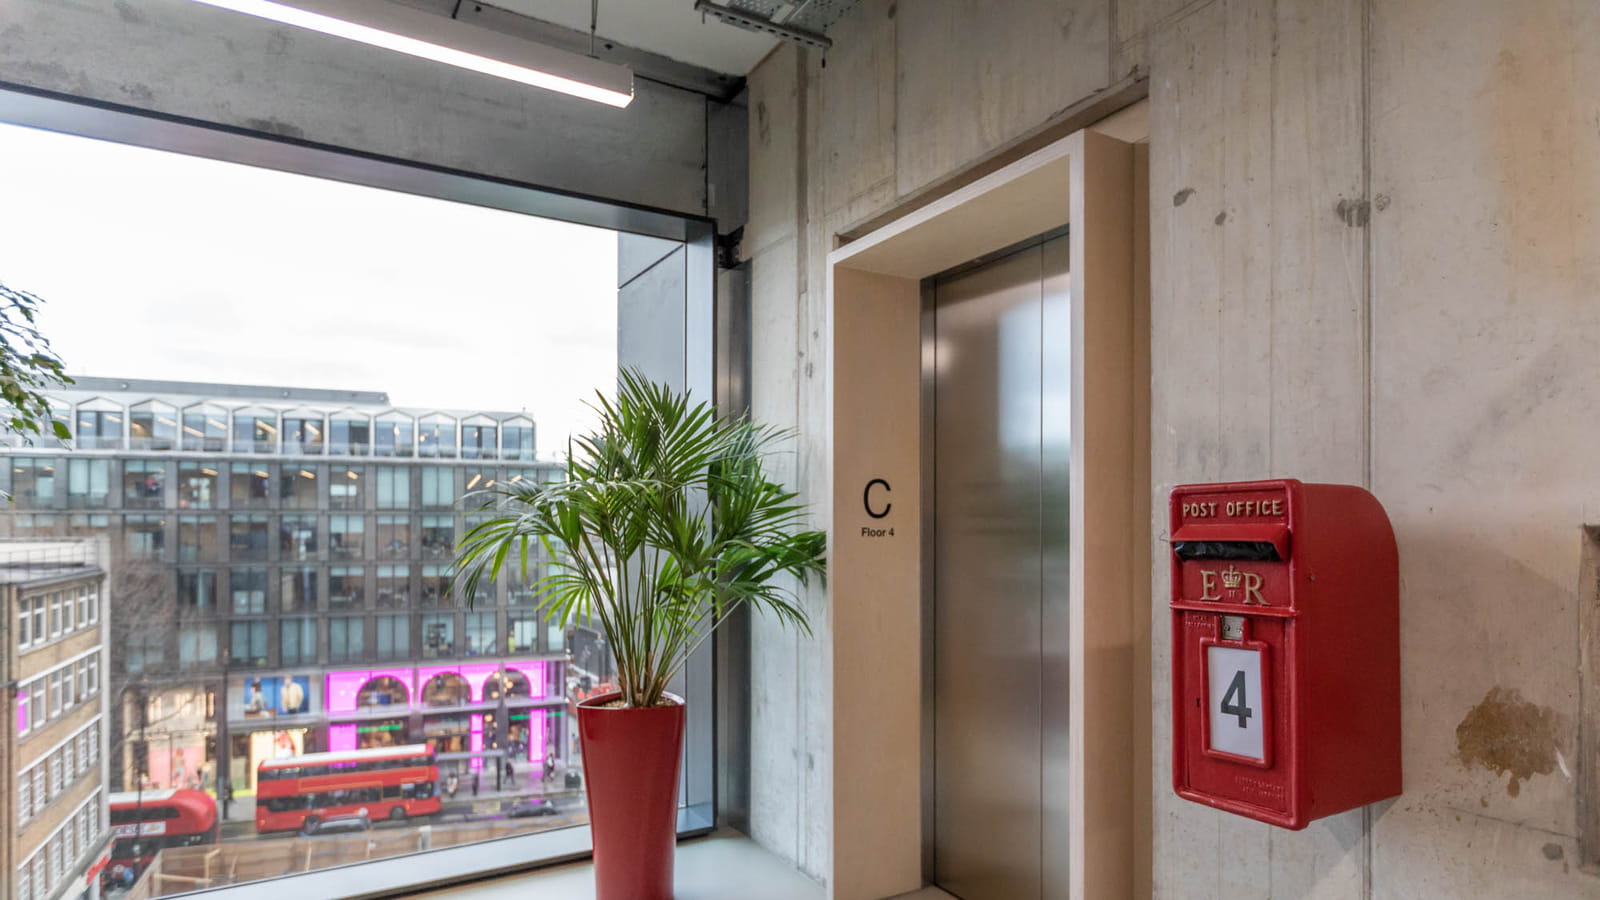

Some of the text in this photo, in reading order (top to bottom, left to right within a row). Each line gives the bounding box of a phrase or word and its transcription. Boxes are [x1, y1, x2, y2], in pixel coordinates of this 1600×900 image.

[864, 478, 892, 519] C
[1182, 499, 1283, 518] POST OFFICE
[861, 527, 895, 537] Floor 4
[1220, 670, 1252, 729] 4
